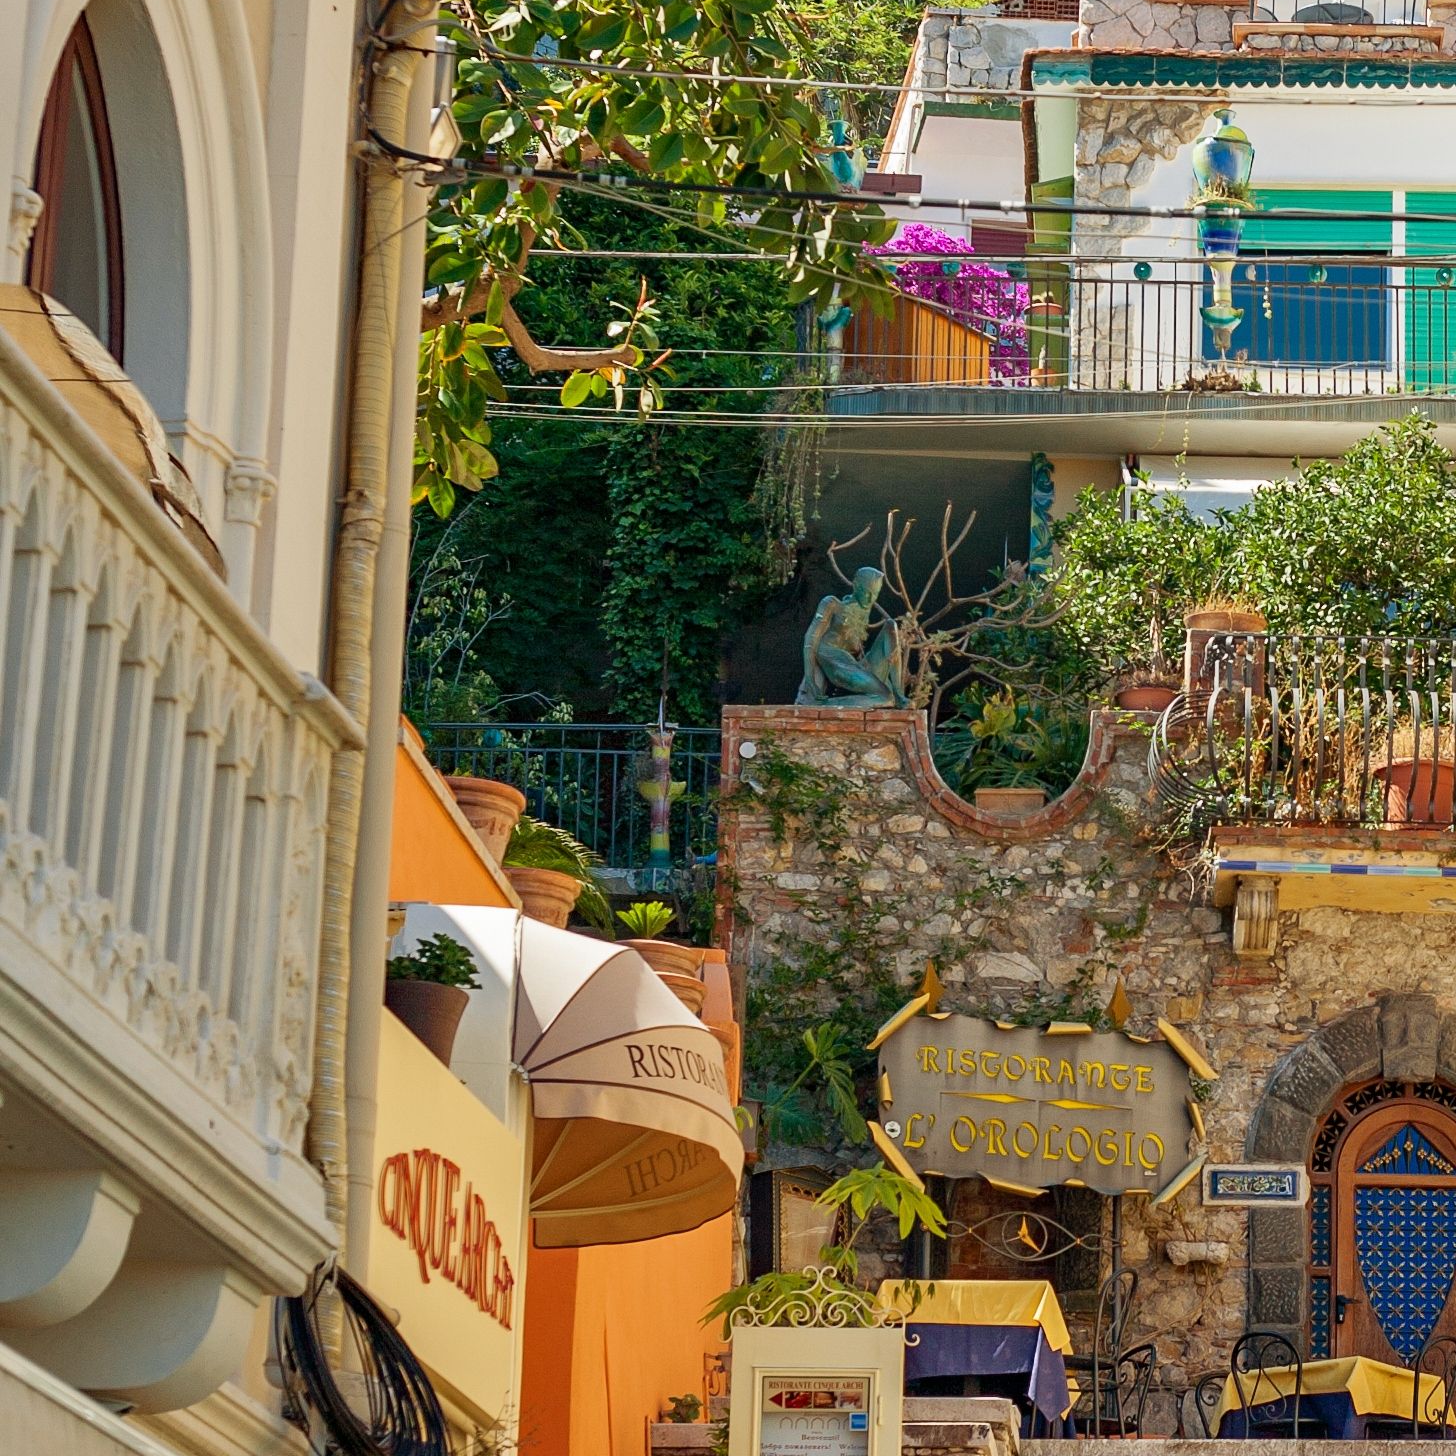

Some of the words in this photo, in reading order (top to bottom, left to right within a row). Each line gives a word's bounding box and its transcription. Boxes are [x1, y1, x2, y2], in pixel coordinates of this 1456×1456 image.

[915, 1044, 1155, 1093] RISTORANTE
[949, 1114, 1166, 1170] OROLOGIO
[378, 1148, 461, 1284] CINQUE
[456, 1180, 515, 1331] ARCHI
[768, 1381, 811, 1390] RISTORANTE
[813, 1381, 839, 1391] CINQUE
[840, 1381, 864, 1390] ARCHI
